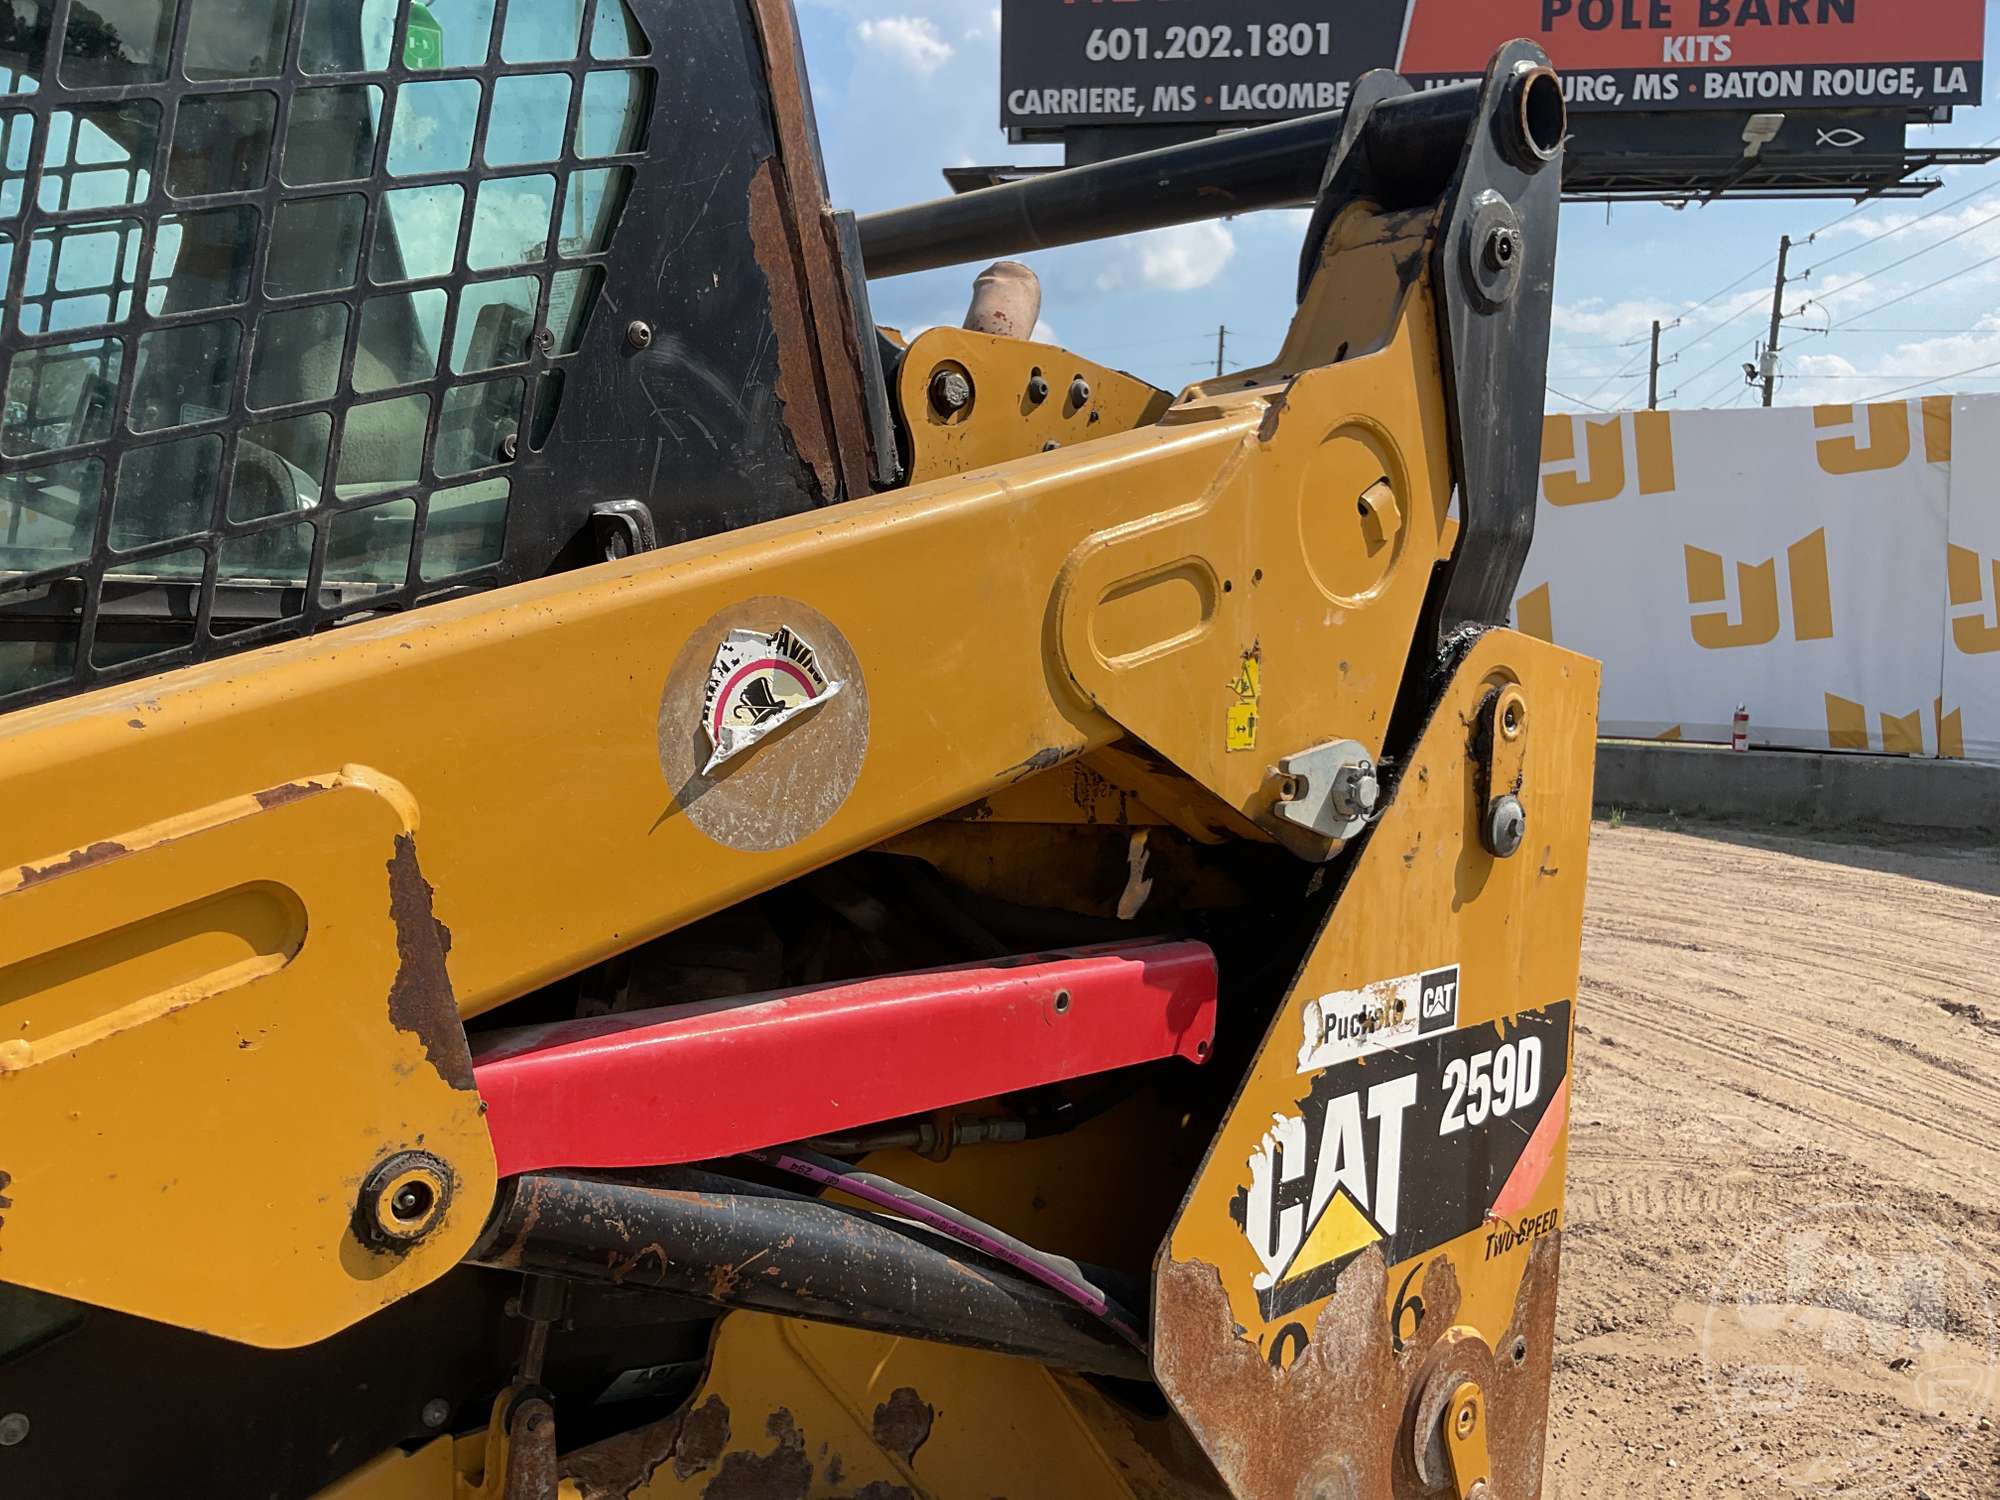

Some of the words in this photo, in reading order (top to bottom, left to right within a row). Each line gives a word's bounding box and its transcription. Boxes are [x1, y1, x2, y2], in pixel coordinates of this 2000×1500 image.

[1541, 0, 1673, 32] POLE
[1700, 0, 1856, 28] BARN
[1085, 22, 1331, 61] 601.202.1801
[1662, 34, 1732, 63] KITS
[1007, 85, 1146, 118] CARRIERE,
[1152, 84, 1196, 112] MS
[1632, 73, 1679, 101] MS
[1704, 69, 1807, 99] BATON
[1812, 66, 1924, 99] ROUGE,
[1933, 66, 1968, 94] LA
[1422, 982, 1456, 1019] CAT
[1438, 1036, 1542, 1137] 259D
[1246, 1073, 1418, 1290] CAT
